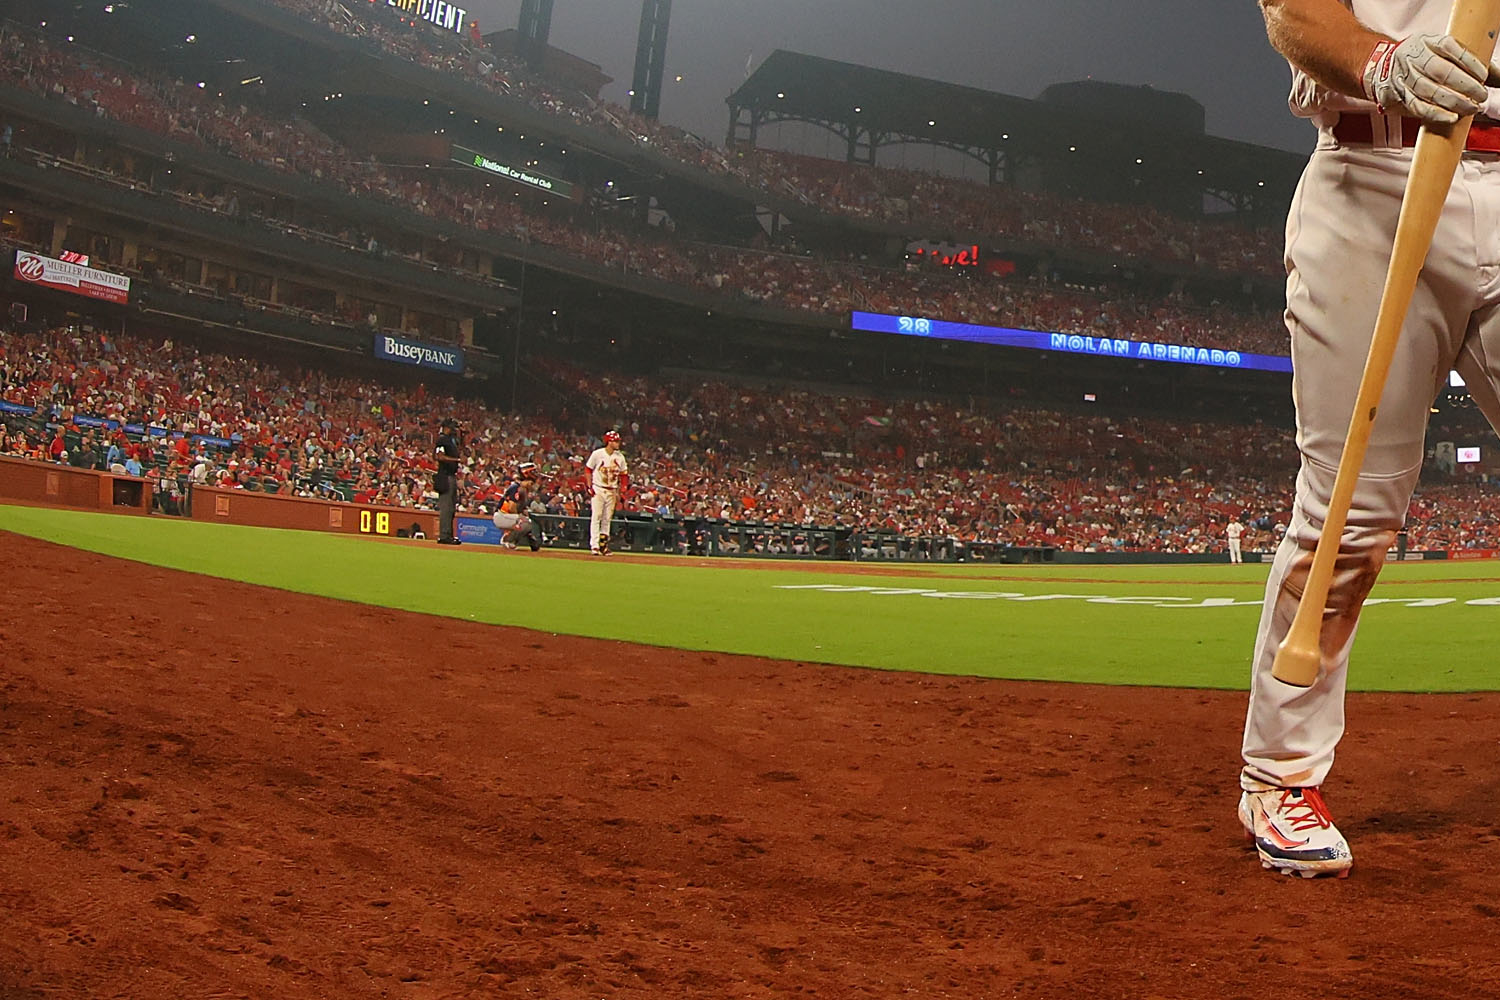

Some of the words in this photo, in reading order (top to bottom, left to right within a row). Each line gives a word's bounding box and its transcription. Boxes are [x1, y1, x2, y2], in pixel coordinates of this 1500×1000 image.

[46, 260, 82, 276] MUELLER
[83, 264, 129, 288] FURNITURE
[898, 316, 930, 336] 28
[1050, 333, 1129, 356] NOLAN
[1138, 342, 1240, 367] ARENADO
